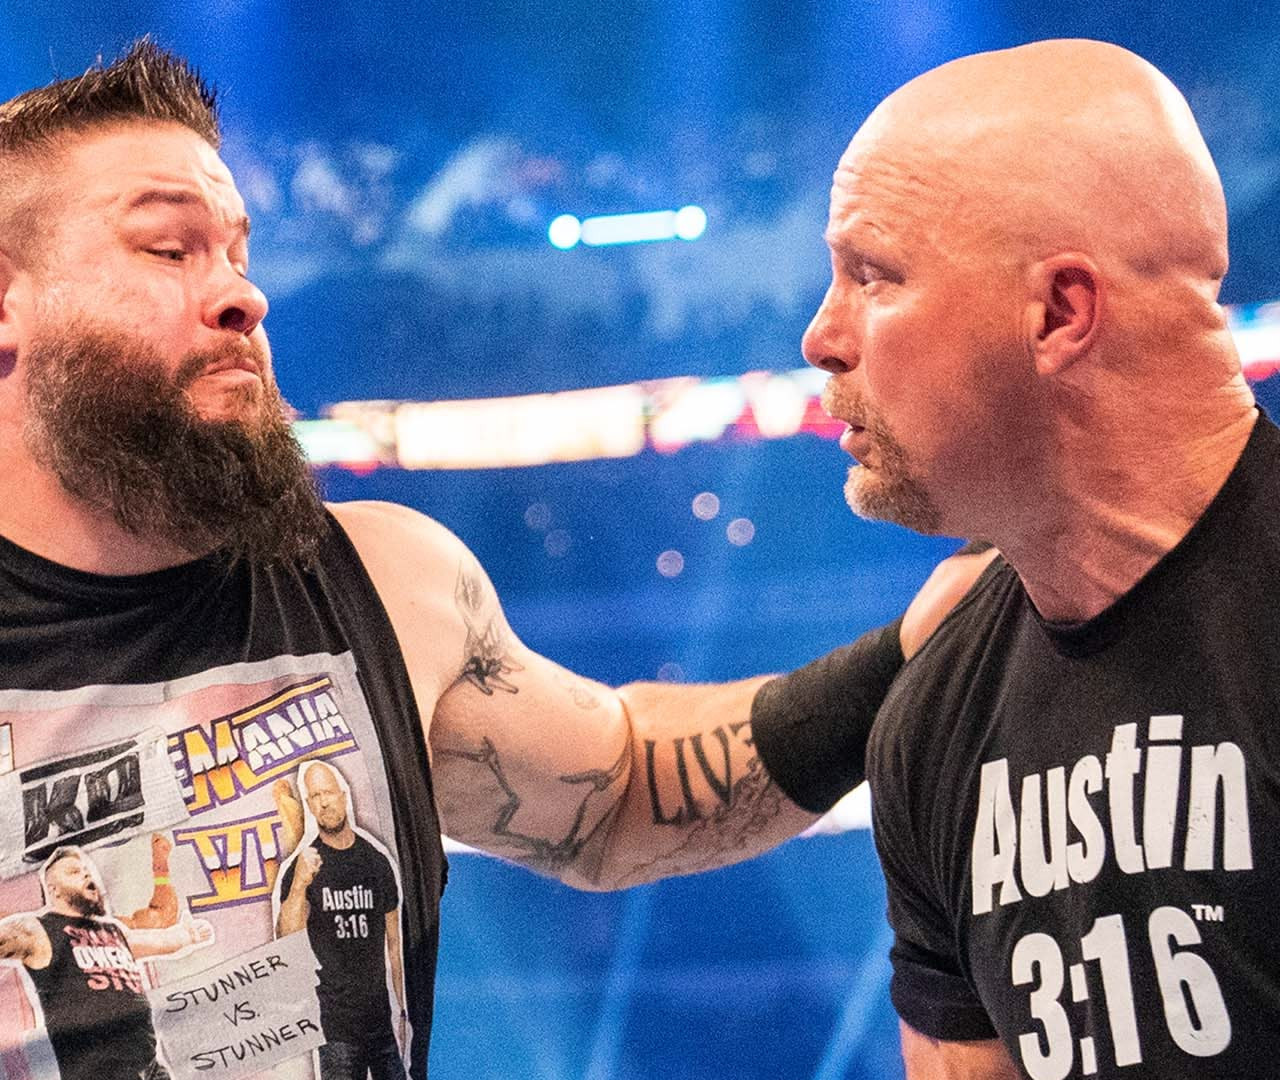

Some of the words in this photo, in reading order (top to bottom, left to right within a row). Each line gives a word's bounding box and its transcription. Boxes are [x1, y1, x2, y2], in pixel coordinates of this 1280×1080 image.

[972, 714, 1254, 916] Austin
[174, 811, 283, 912] VI
[322, 884, 374, 911] Austin
[334, 913, 369, 939] 3:16
[166, 954, 288, 1013] STUNNER
[223, 1000, 261, 1027] VS.
[190, 1018, 319, 1071] STUNNER
